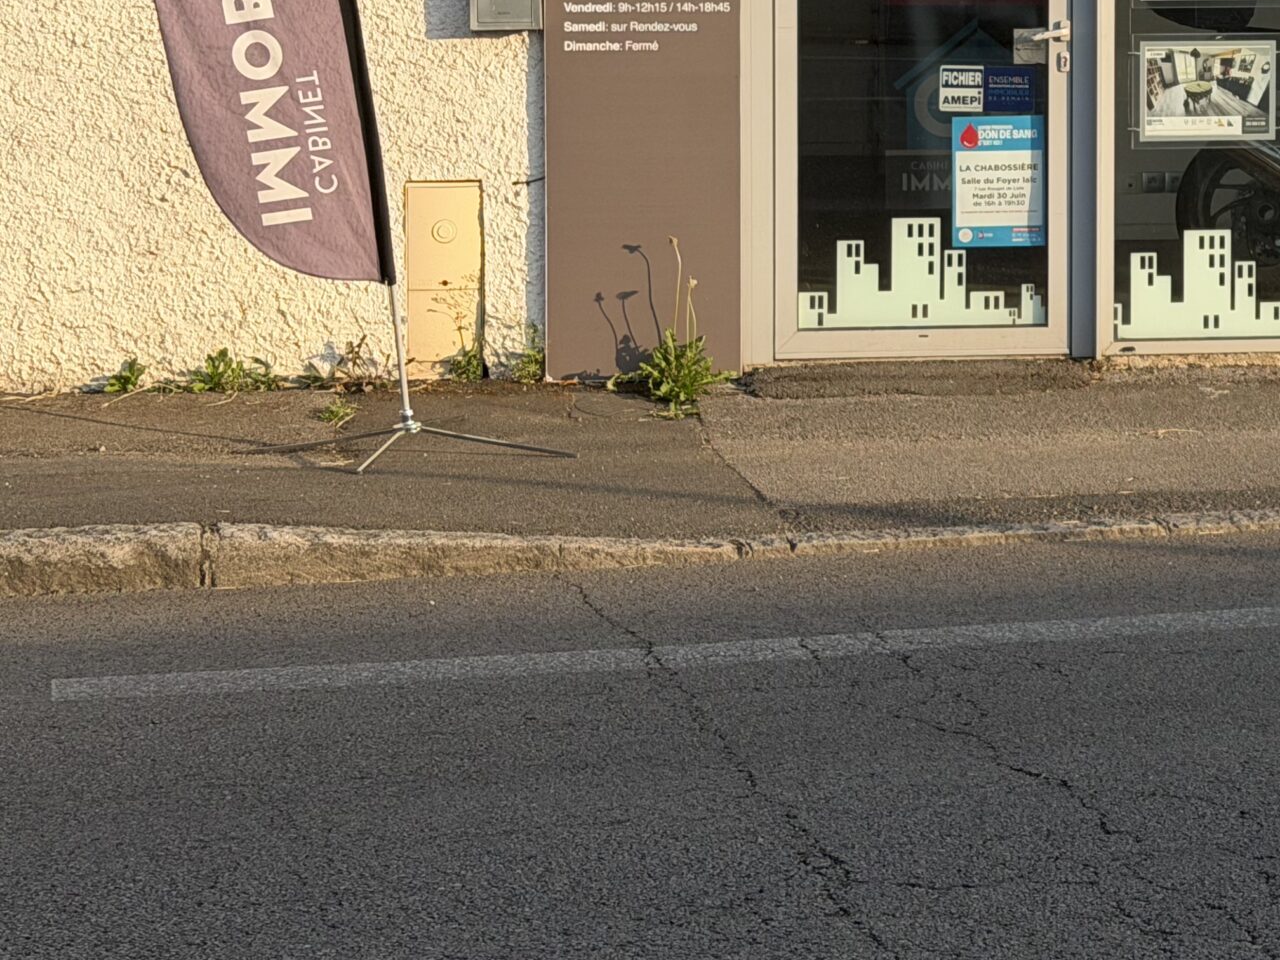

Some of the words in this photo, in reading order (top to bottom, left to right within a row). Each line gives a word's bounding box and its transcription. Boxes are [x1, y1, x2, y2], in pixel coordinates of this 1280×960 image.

[563, 2, 616, 13] Vendredi:
[618, 2, 667, 13] 9h-12h15
[676, 2, 731, 13] 14h-18h45
[563, 21, 608, 32] Samedi:
[611, 23, 627, 32] sur
[630, 21, 698, 32] Rendez-vous
[563, 41, 623, 51] Dimanche:
[625, 40, 659, 51] Fermé
[942, 71, 982, 87] FICHIER
[989, 75, 1029, 84] ENSEMBLE
[978, 129, 998, 139] DON
[1000, 129, 1011, 138] DE
[959, 164, 971, 172] LA
[974, 162, 1039, 172] CHABOSSIÈRE
[961, 177, 981, 185] Salle
[996, 176, 1020, 186] Foyer
[1009, 191, 1026, 199] Juin
